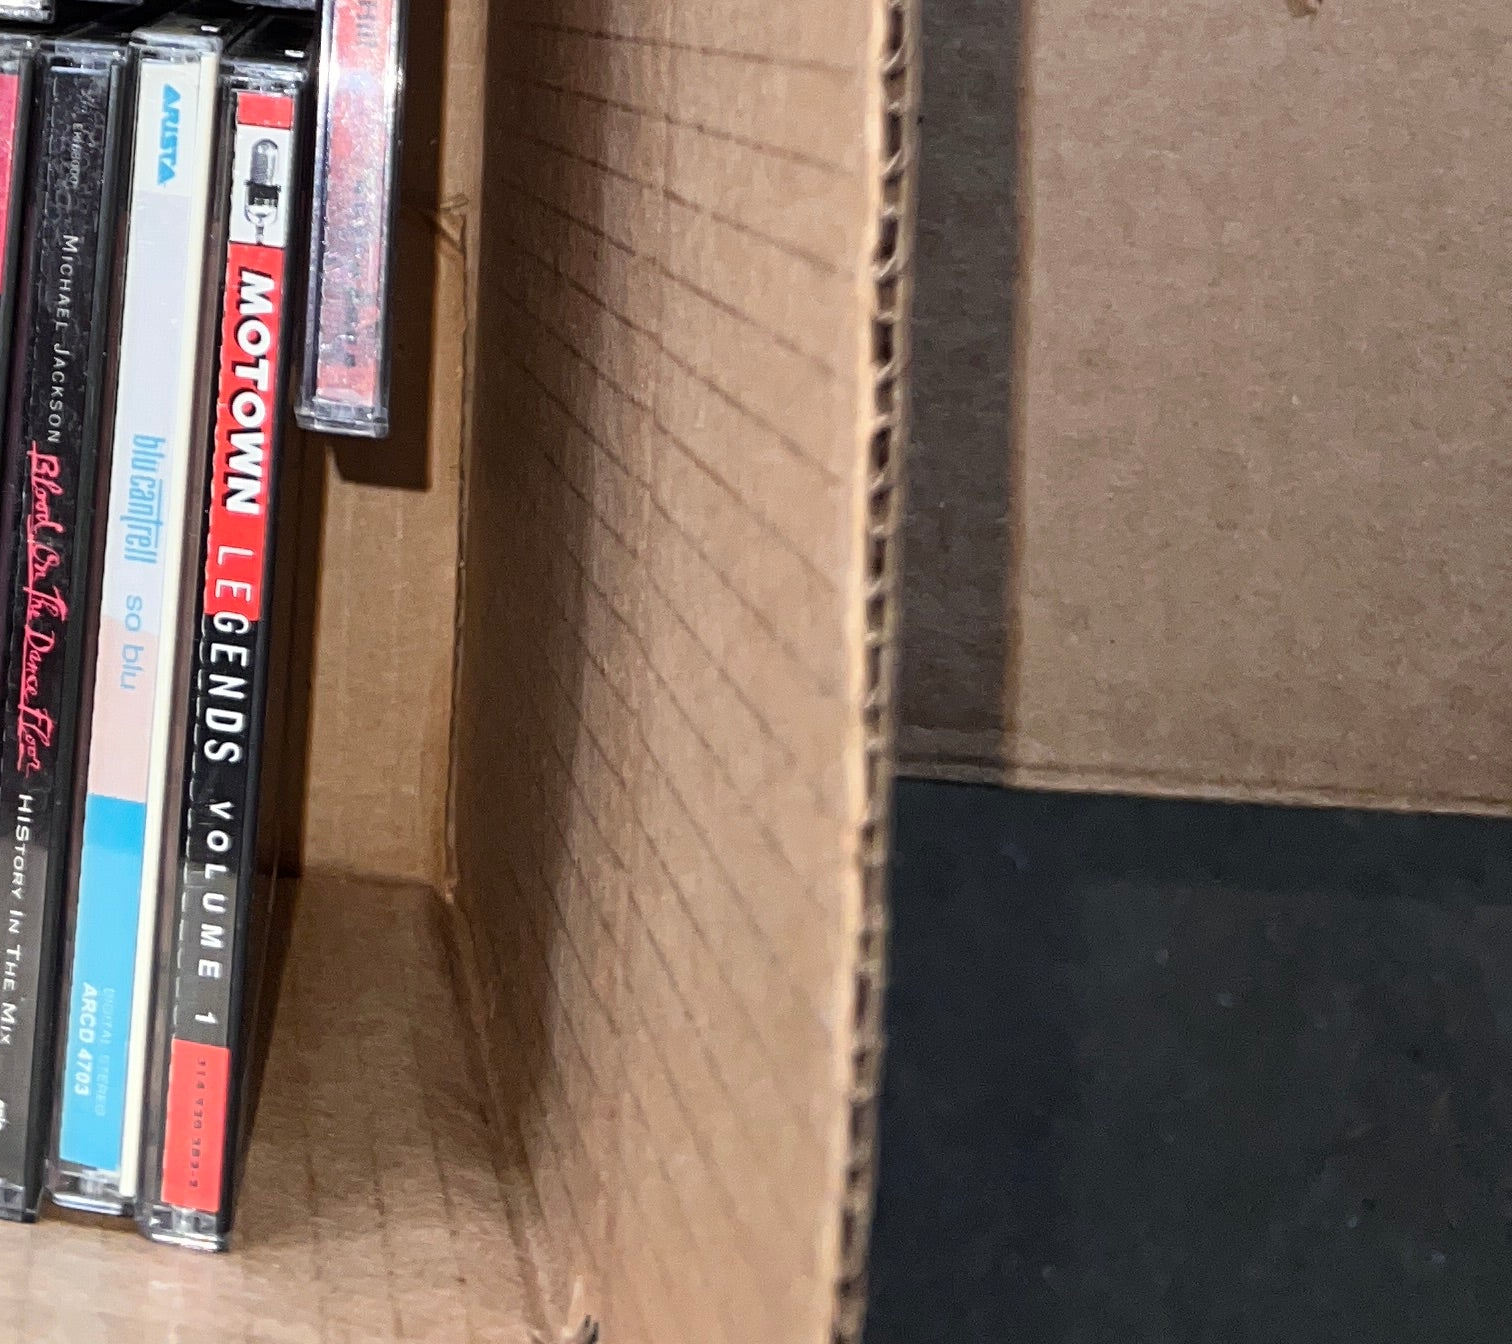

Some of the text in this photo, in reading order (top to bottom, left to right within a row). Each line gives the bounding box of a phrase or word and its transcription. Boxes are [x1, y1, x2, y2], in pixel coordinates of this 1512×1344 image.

[194, 269, 275, 1026] MOTOWN LEGENDS VOLUME 1
[0, 793, 34, 1045] HISTORY IN THE MIX
[73, 982, 98, 1096] ARCD 4703
